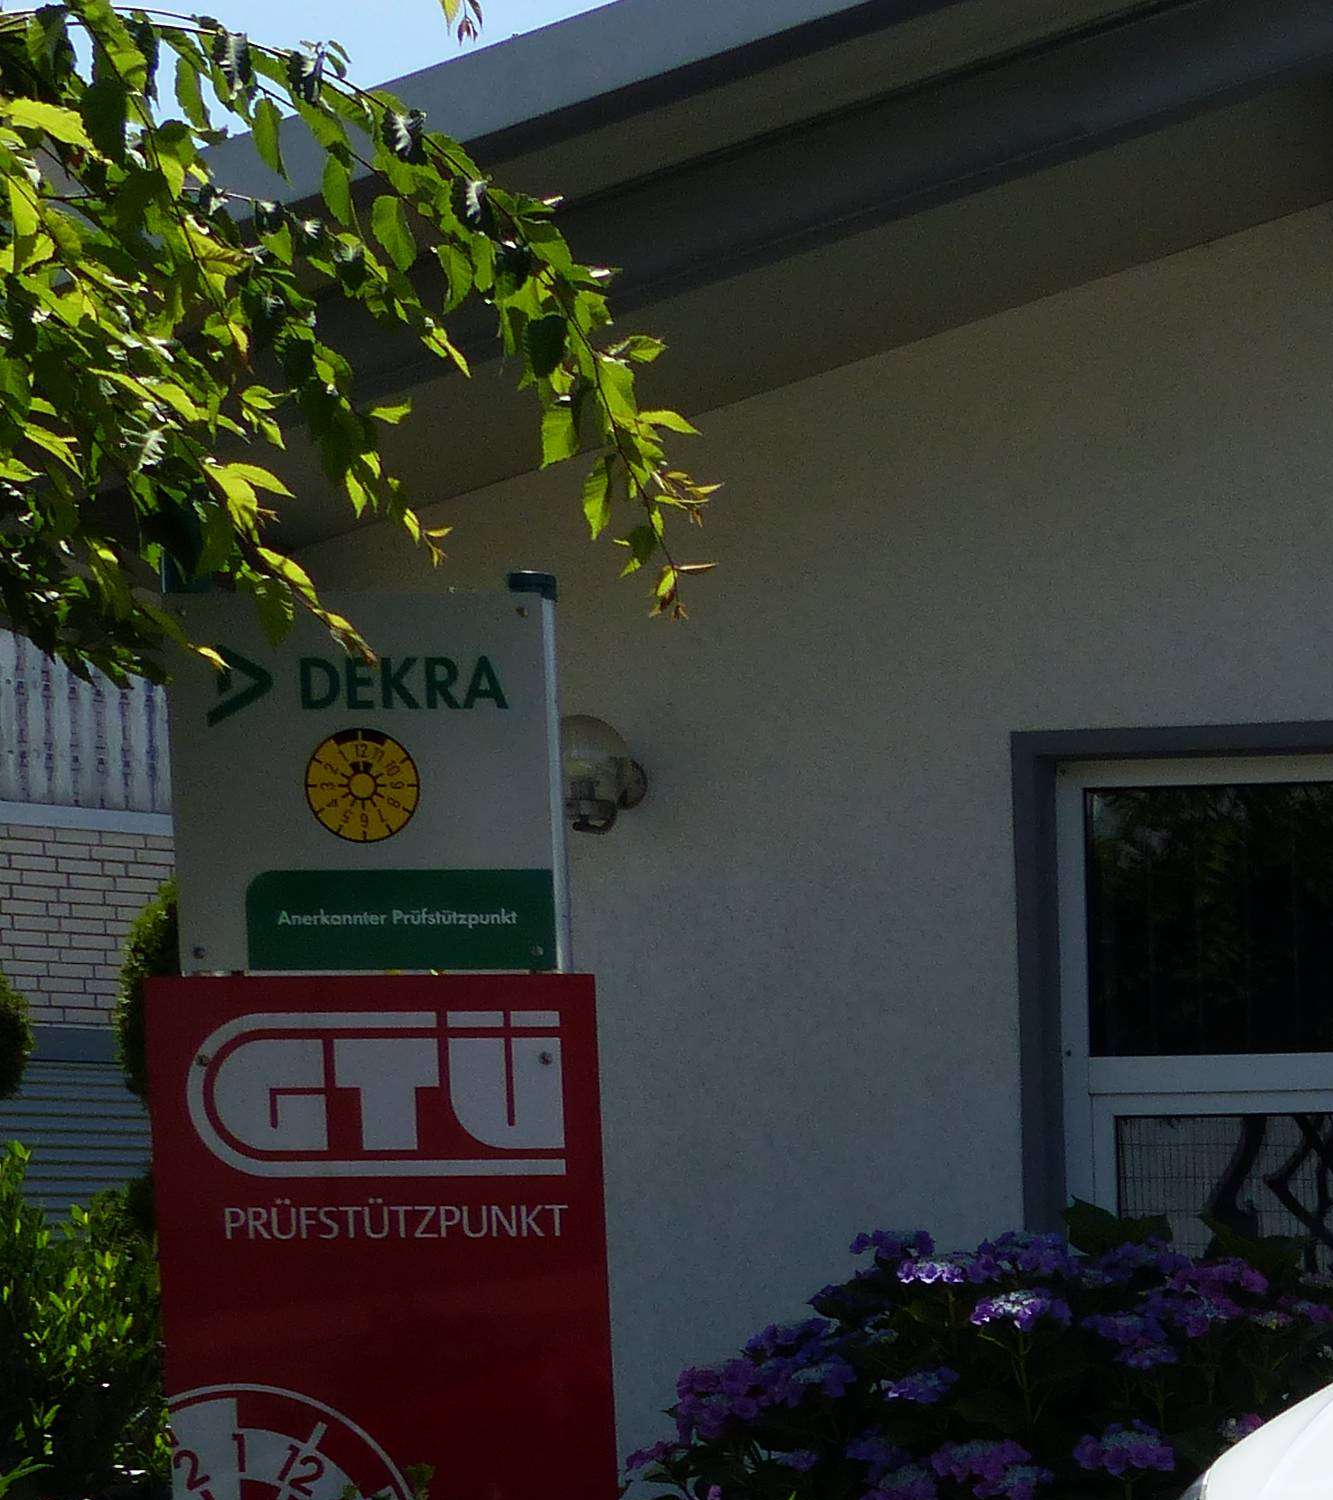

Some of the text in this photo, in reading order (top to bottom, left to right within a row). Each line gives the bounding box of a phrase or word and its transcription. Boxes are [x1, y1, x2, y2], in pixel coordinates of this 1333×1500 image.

[299, 655, 509, 710] DEKRA
[355, 743, 368, 758] 12
[278, 908, 519, 928] Anerkannter Prüfstützpunkt
[190, 1010, 566, 1172] GTÜ
[224, 1198, 569, 1241] PRÜFSTÜTZPUNKT
[173, 1433, 326, 1498] 2 1 12
